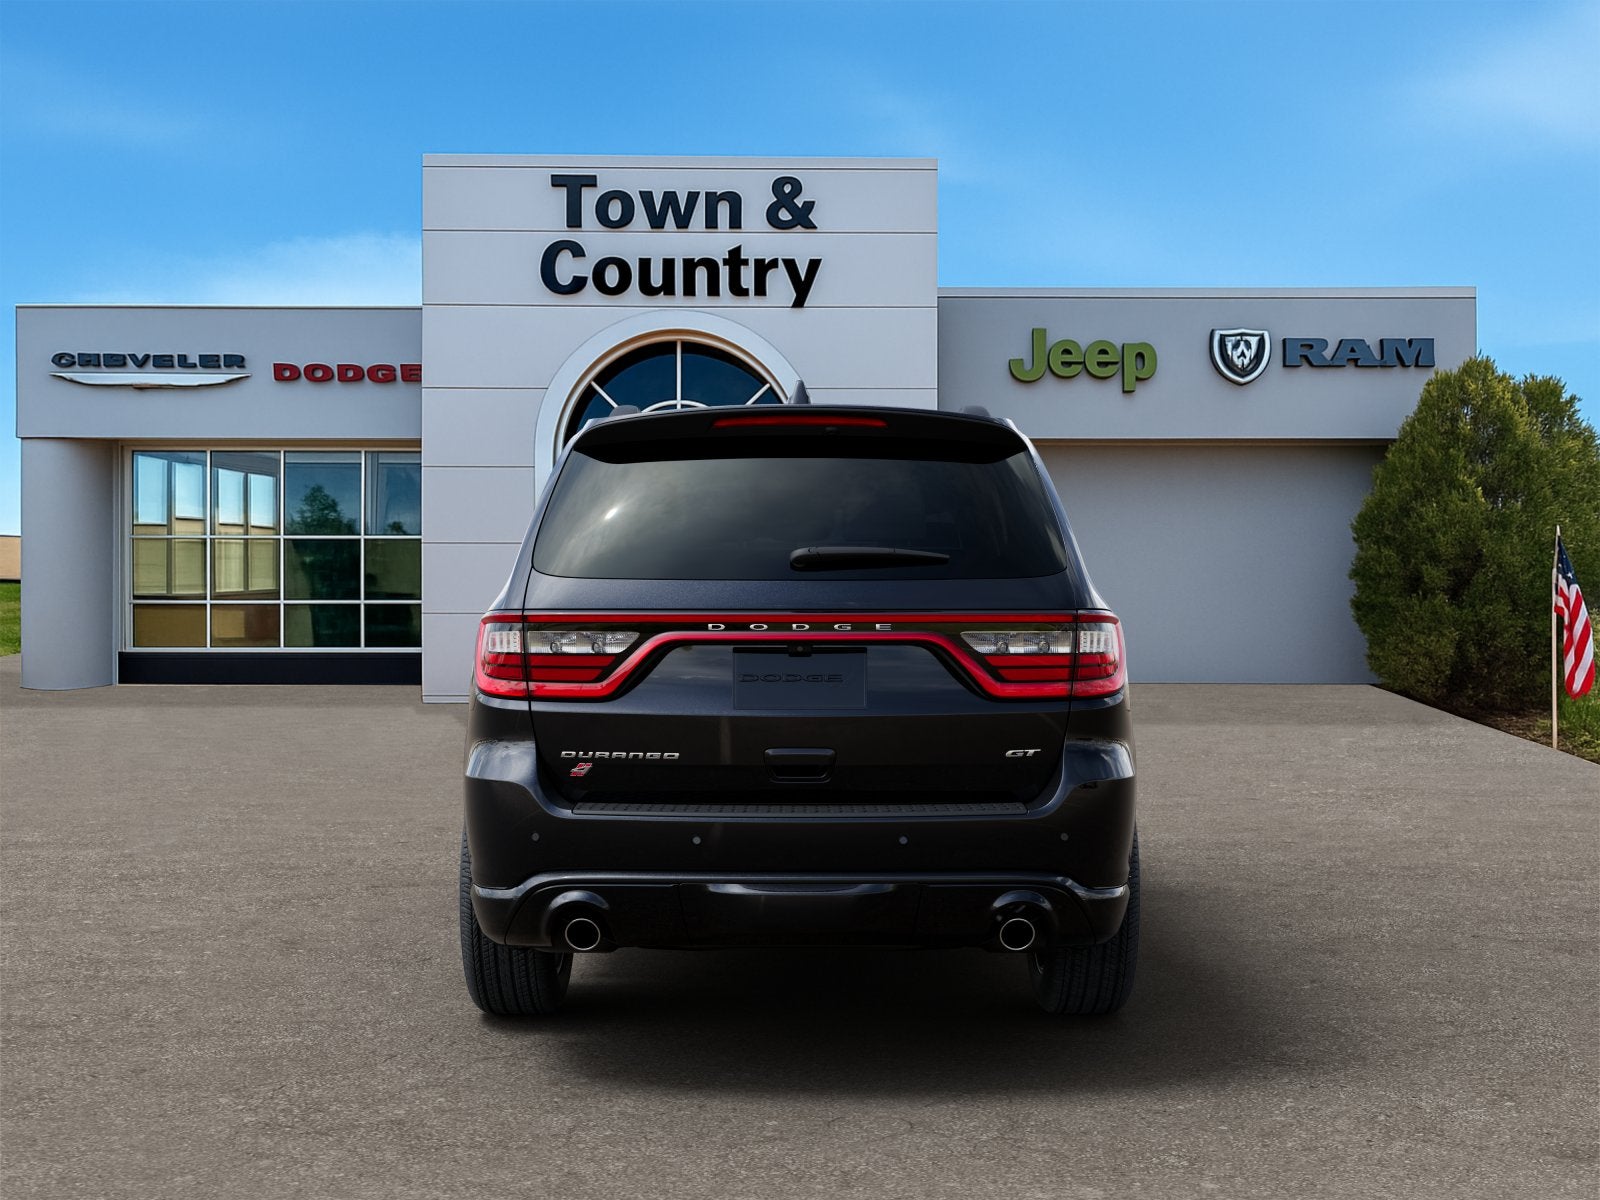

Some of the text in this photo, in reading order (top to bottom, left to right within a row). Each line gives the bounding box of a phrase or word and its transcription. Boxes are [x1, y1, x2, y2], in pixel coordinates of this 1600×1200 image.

[551, 173, 818, 230] Town &
[539, 239, 822, 309] Country
[1008, 327, 1158, 393] Jeep
[1282, 337, 1436, 368] RAM
[272, 362, 422, 383] DODGE
[707, 623, 892, 631] DODGE
[739, 673, 844, 683] DODGE
[560, 751, 680, 760] DURANGO
[1005, 748, 1042, 758] GT
